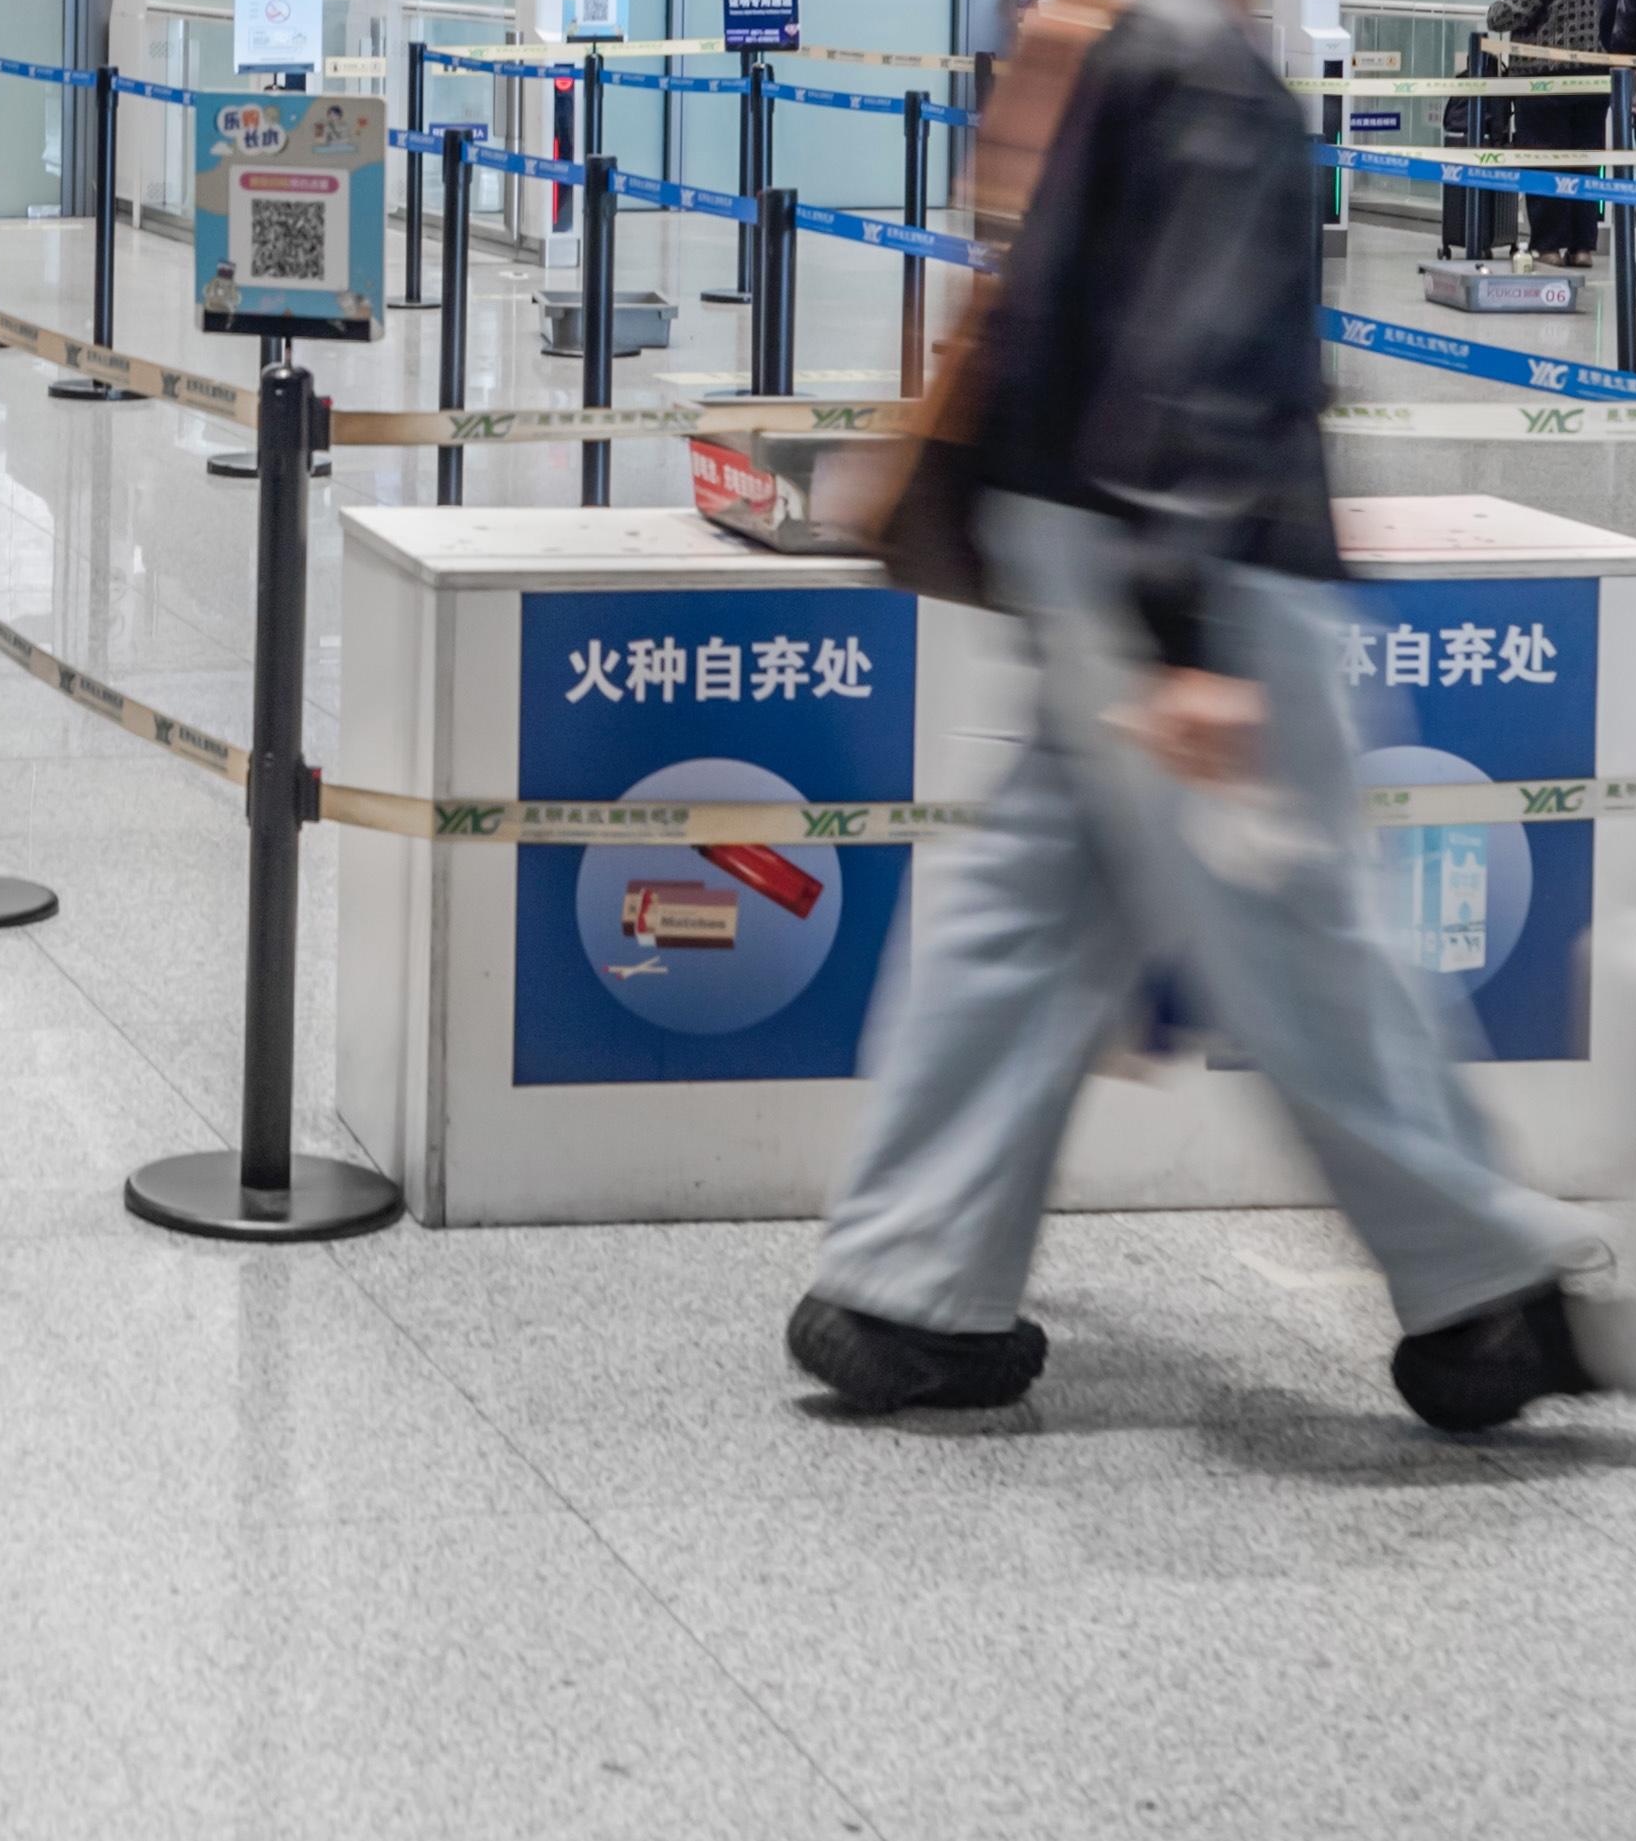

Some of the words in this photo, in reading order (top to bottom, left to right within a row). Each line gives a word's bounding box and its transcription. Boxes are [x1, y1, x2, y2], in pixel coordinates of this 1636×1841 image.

[1545, 289, 1566, 303] 06
[564, 635, 875, 704] 火种自弃处
